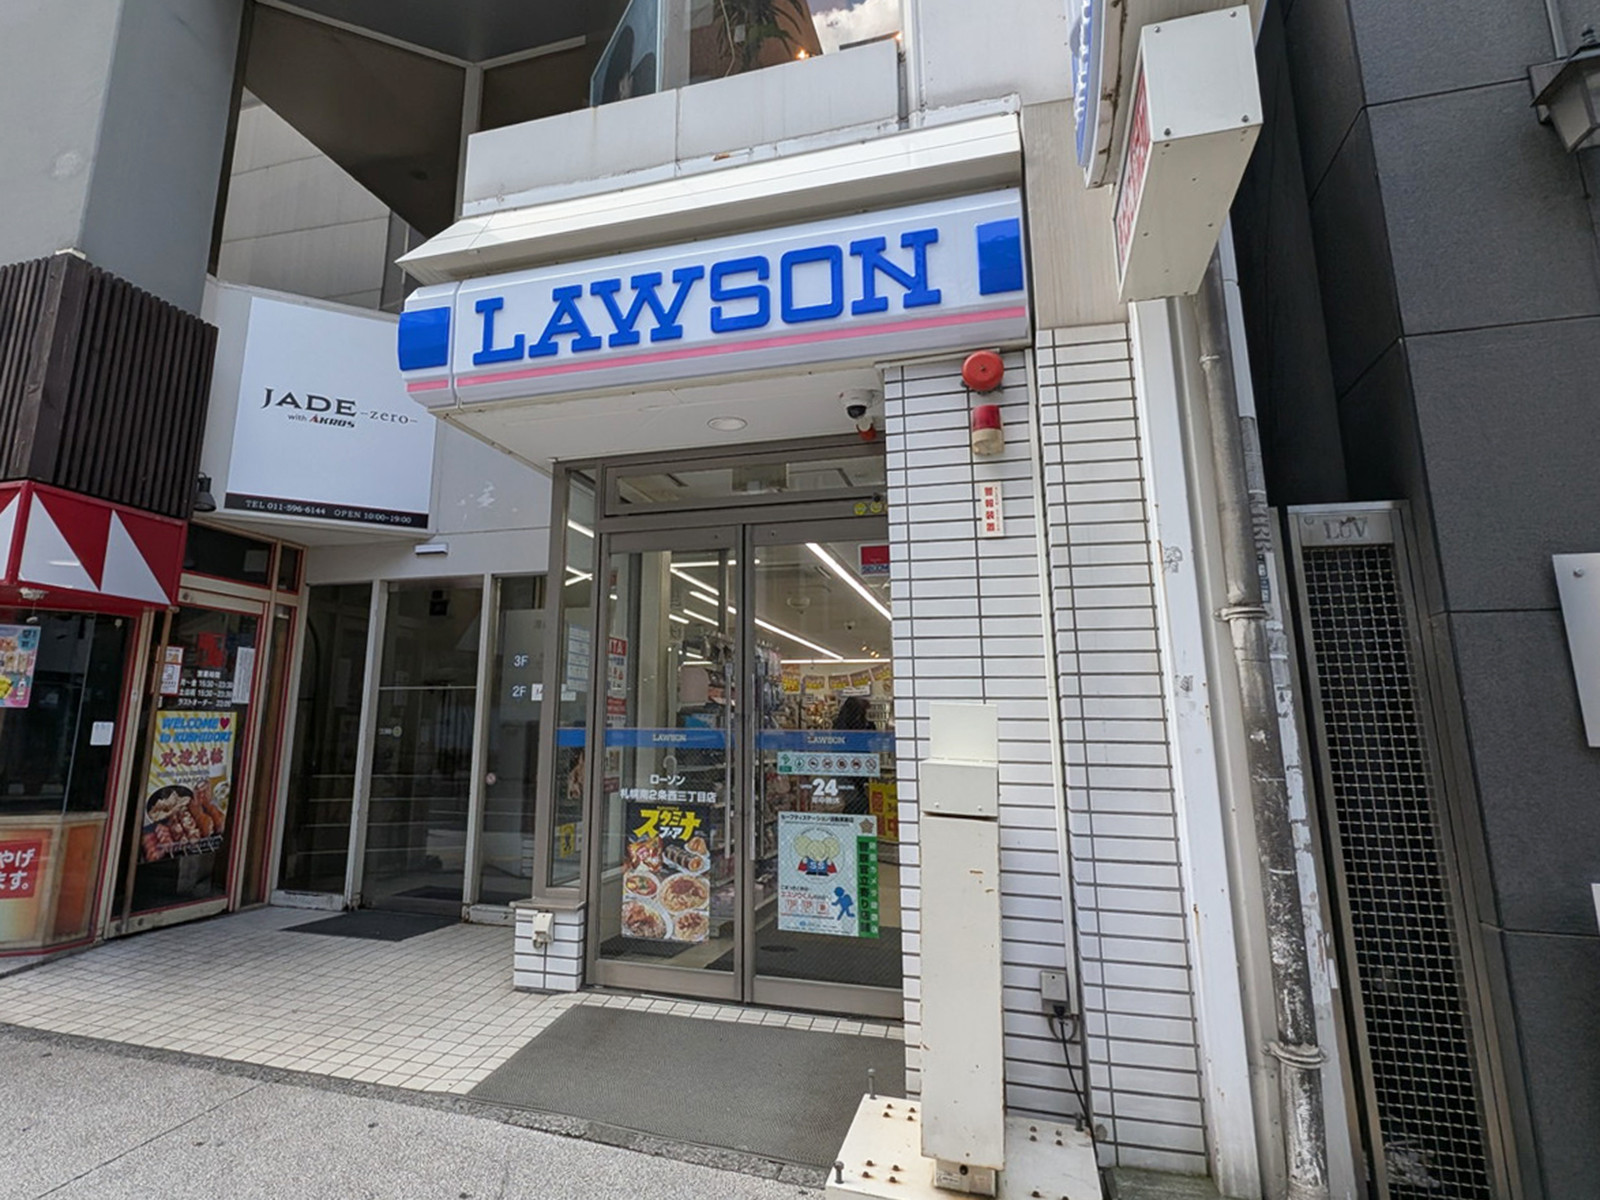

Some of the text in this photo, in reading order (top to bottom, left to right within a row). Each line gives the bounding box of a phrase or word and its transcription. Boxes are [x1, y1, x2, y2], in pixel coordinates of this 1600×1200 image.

[472, 227, 942, 366] LAWSON
[260, 387, 358, 418] JADE
[287, 413, 307, 422] with
[245, 499, 265, 510] TEL
[267, 501, 327, 516] 011-596-6144
[333, 508, 361, 519] OPEN
[513, 654, 529, 668] 3F
[511, 684, 527, 698] 2F
[162, 717, 219, 729] WELCOME
[652, 733, 687, 742] LAWSON
[807, 735, 846, 745] LAWSON
[649, 773, 686, 786] ローソン
[812, 777, 839, 797] 24
[633, 808, 702, 842] スタミナ
